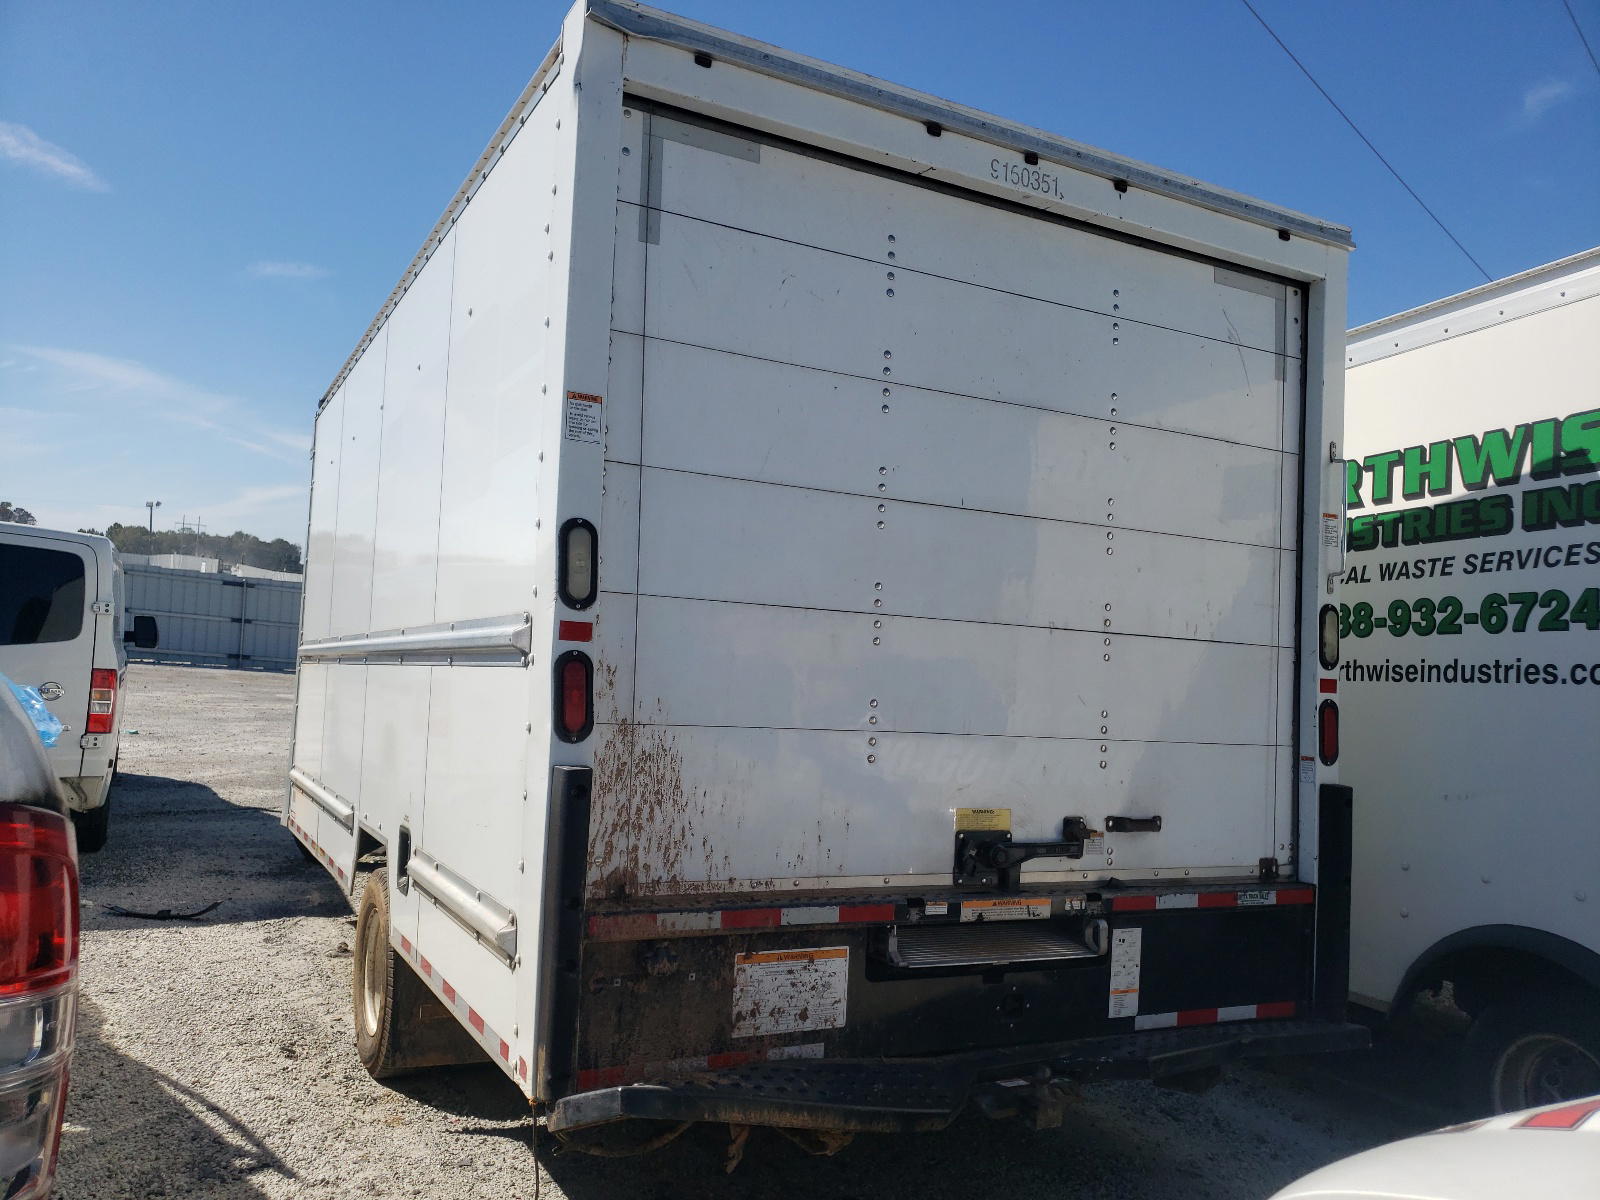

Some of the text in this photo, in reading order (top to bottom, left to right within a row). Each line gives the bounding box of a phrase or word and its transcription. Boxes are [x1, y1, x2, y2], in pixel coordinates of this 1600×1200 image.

[1346, 494, 1514, 553] STRIES
[1340, 541, 1600, 585] AL WASTE SERVICES
